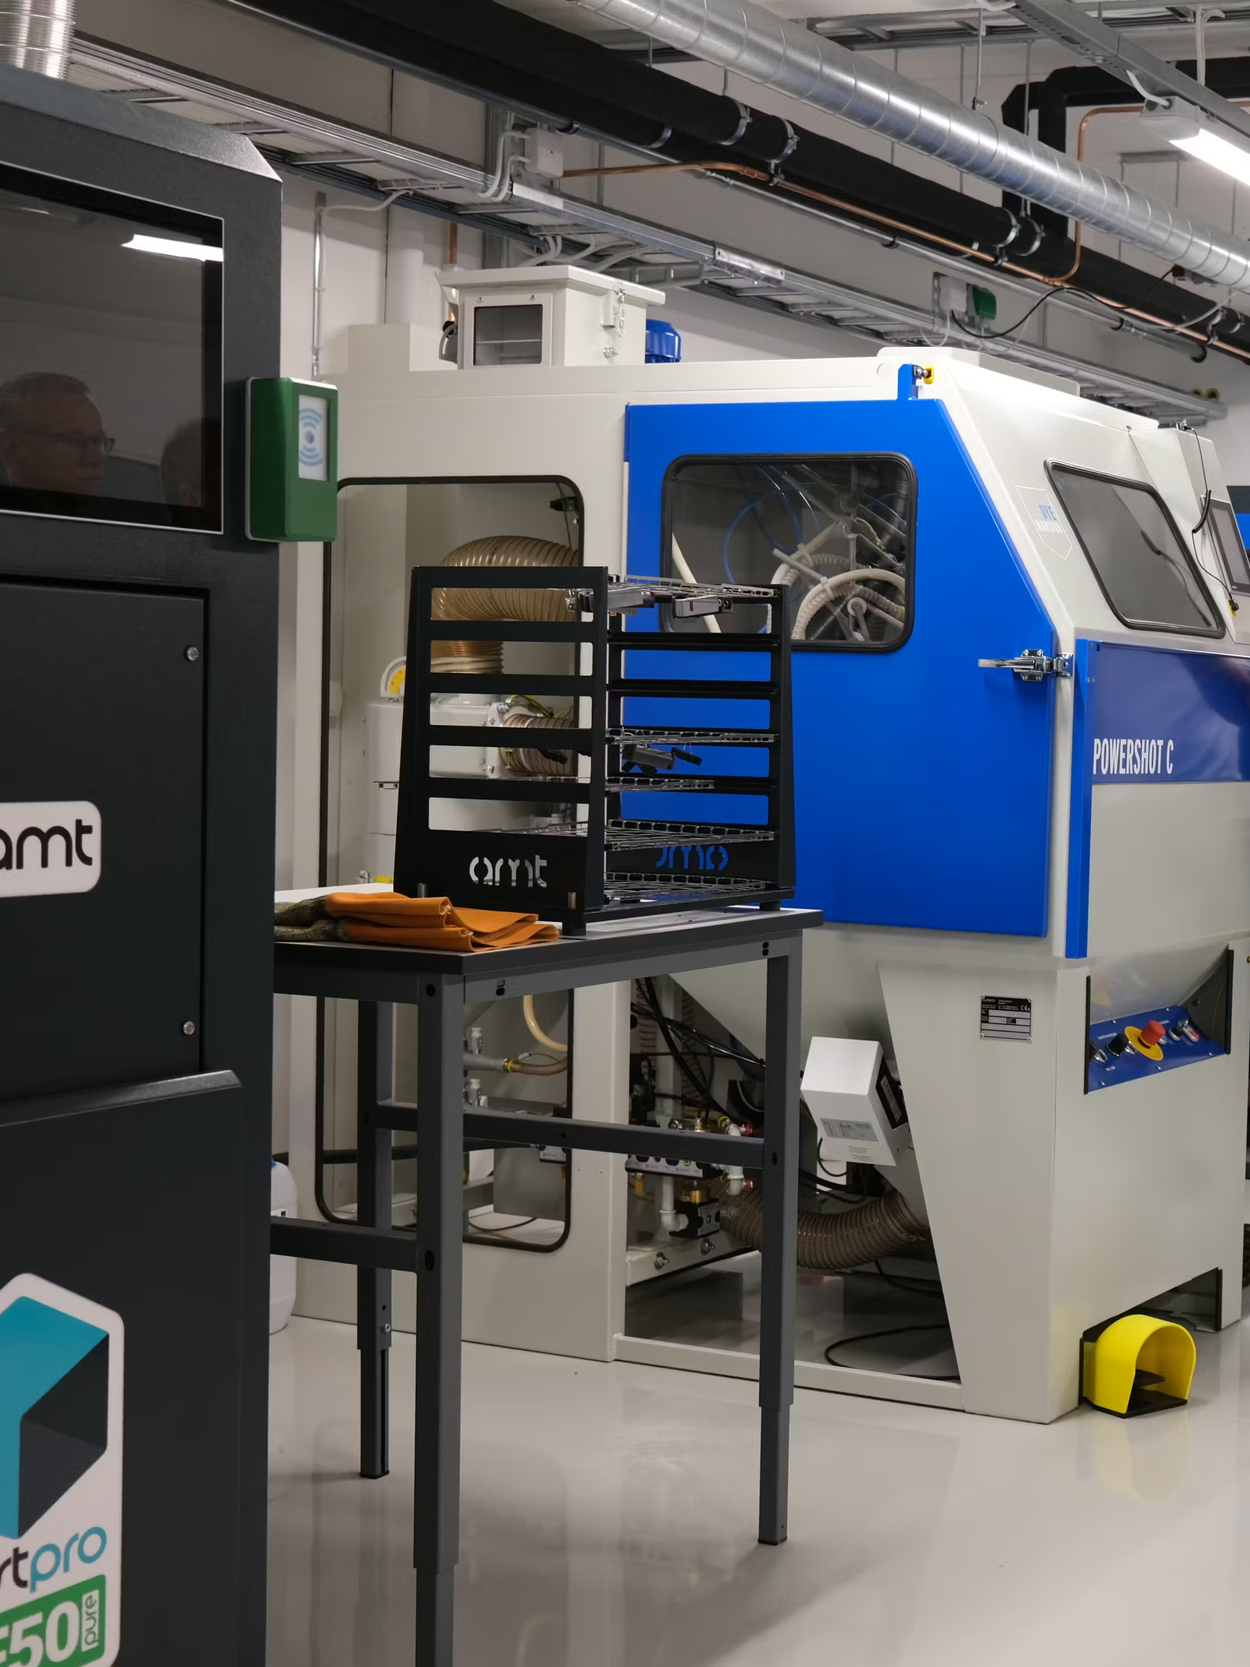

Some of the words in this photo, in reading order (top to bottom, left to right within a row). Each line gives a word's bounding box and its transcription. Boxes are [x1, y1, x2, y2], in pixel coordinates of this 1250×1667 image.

[1093, 738, 1164, 775] POWERSHOT
[1166, 739, 1174, 775] C
[469, 854, 548, 888] amt
[84, 1594, 99, 1647] pure
